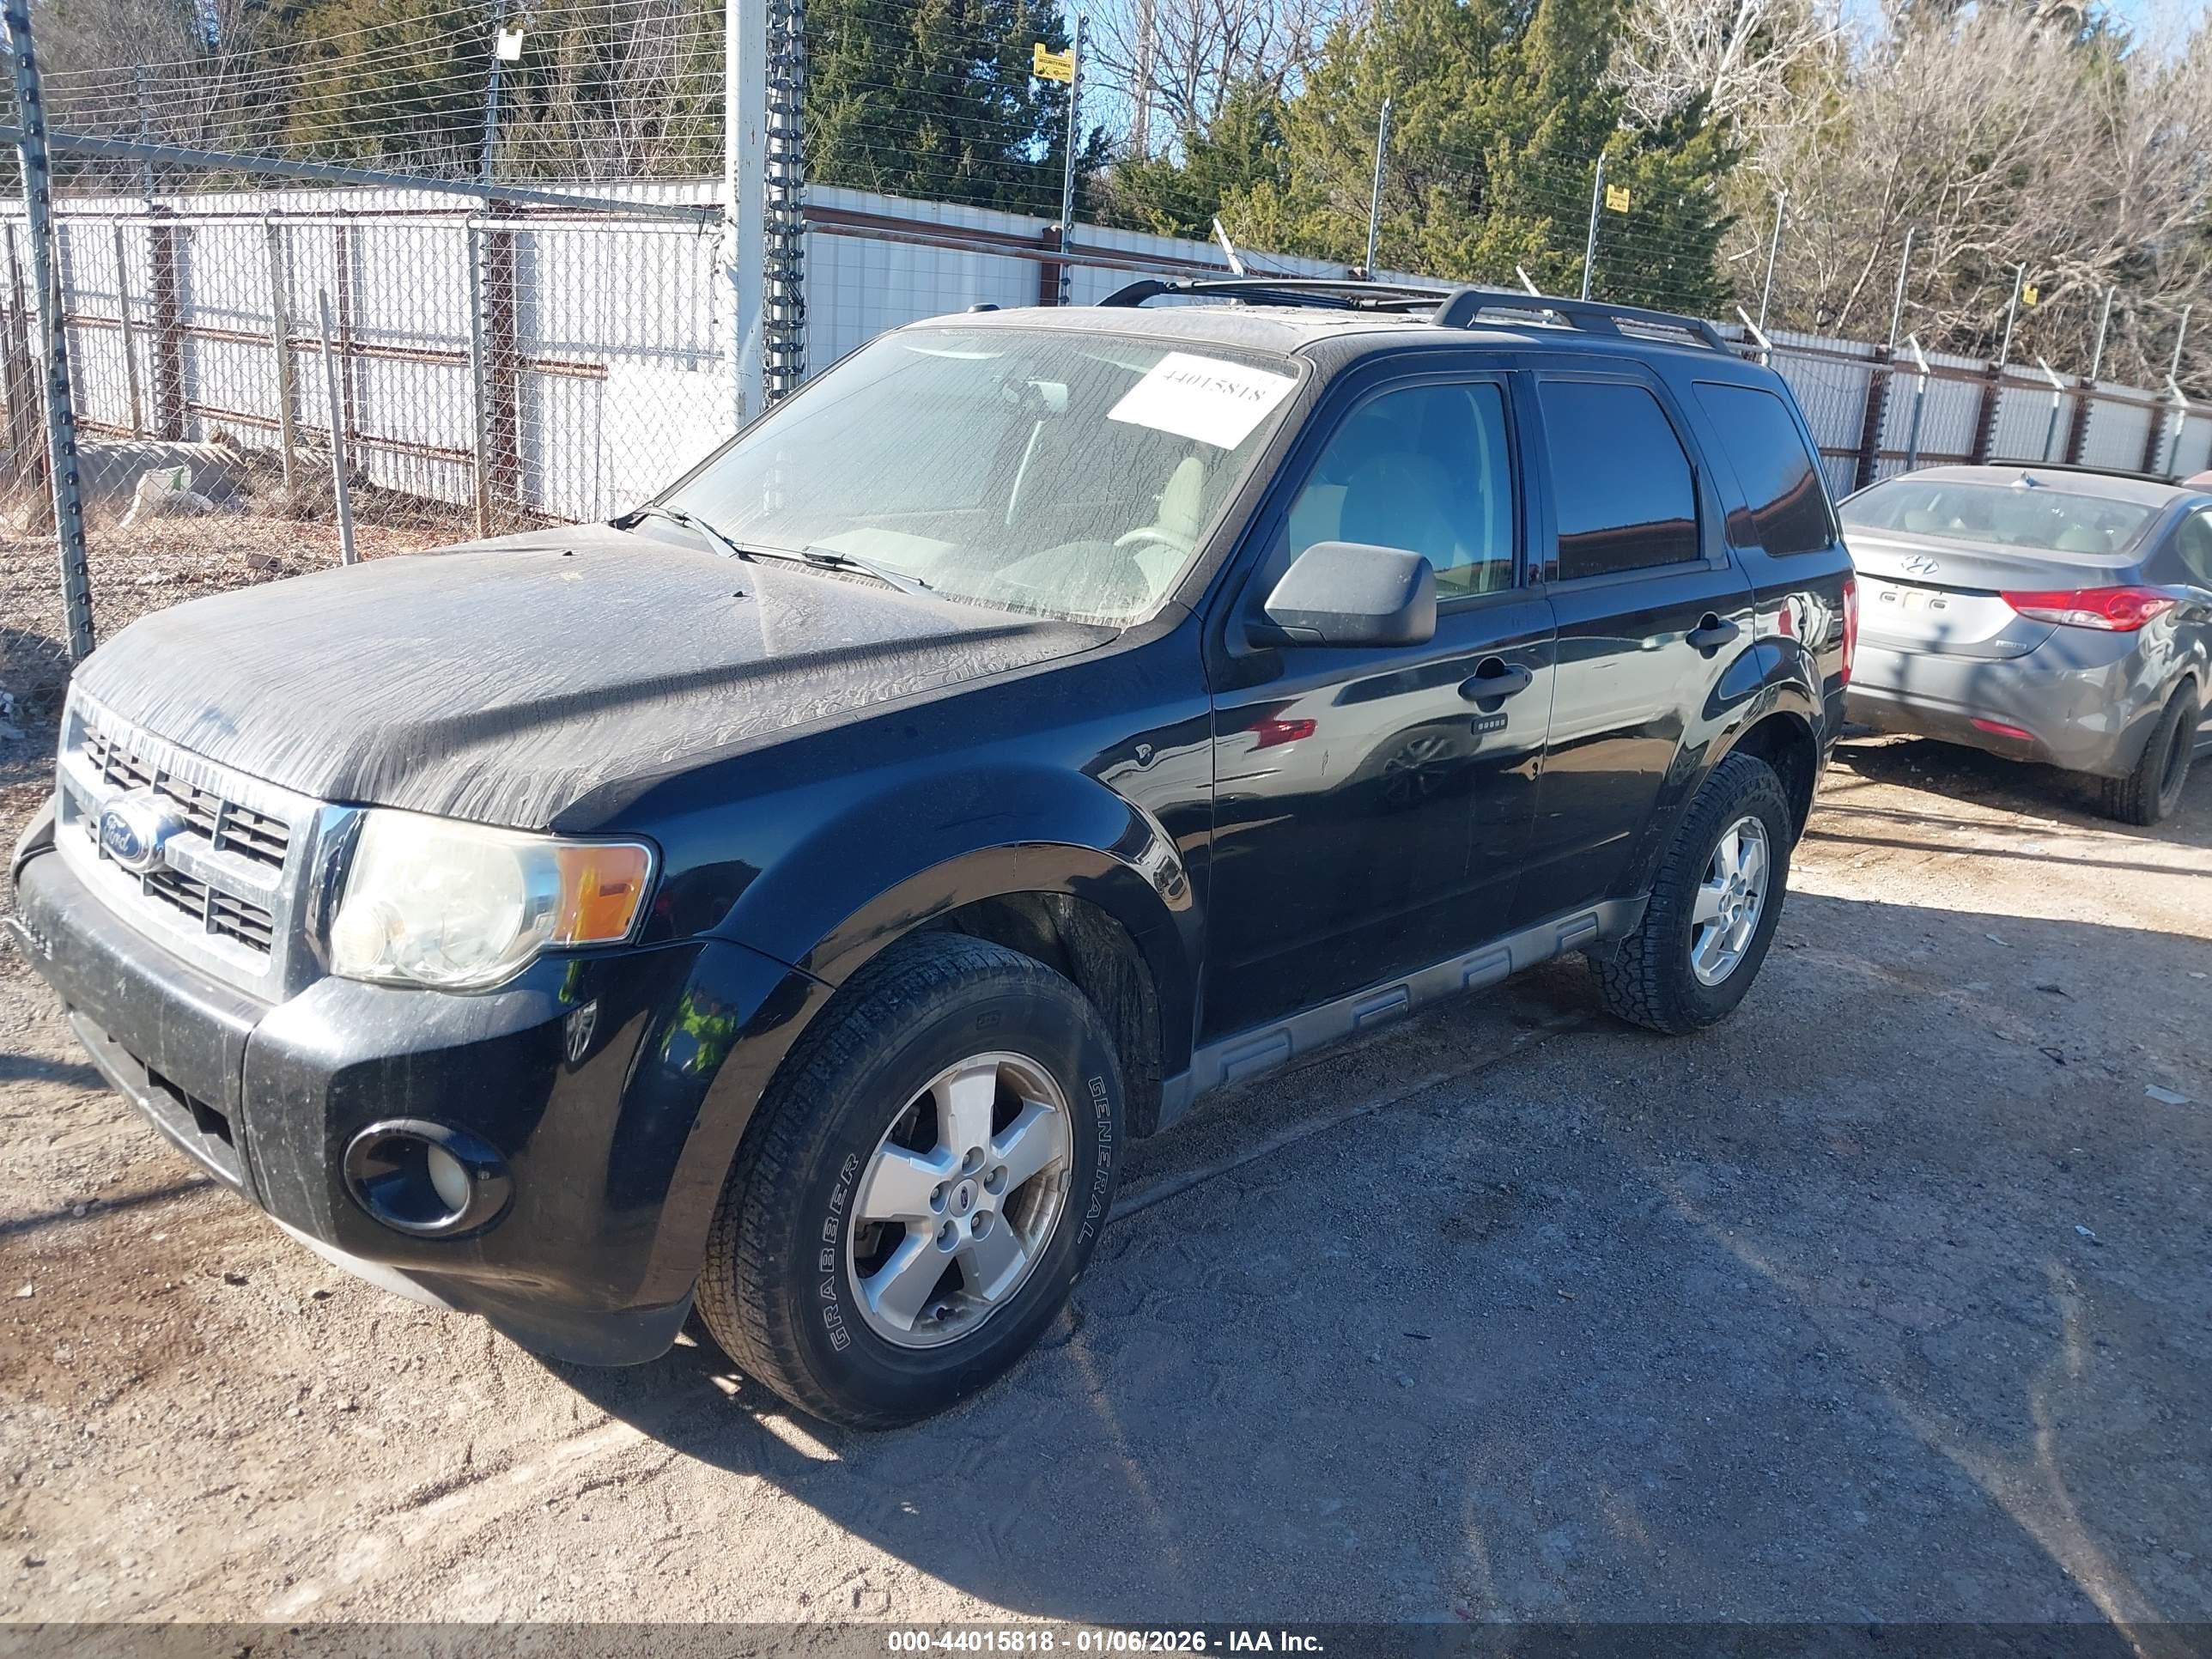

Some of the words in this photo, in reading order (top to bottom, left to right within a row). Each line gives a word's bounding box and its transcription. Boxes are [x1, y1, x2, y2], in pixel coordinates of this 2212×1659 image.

[1163, 370, 1267, 401] 44015818
[103, 814, 131, 852] Ford
[1077, 1075, 1112, 1244] GENERAL
[819, 1152, 859, 1352] GRABBER
